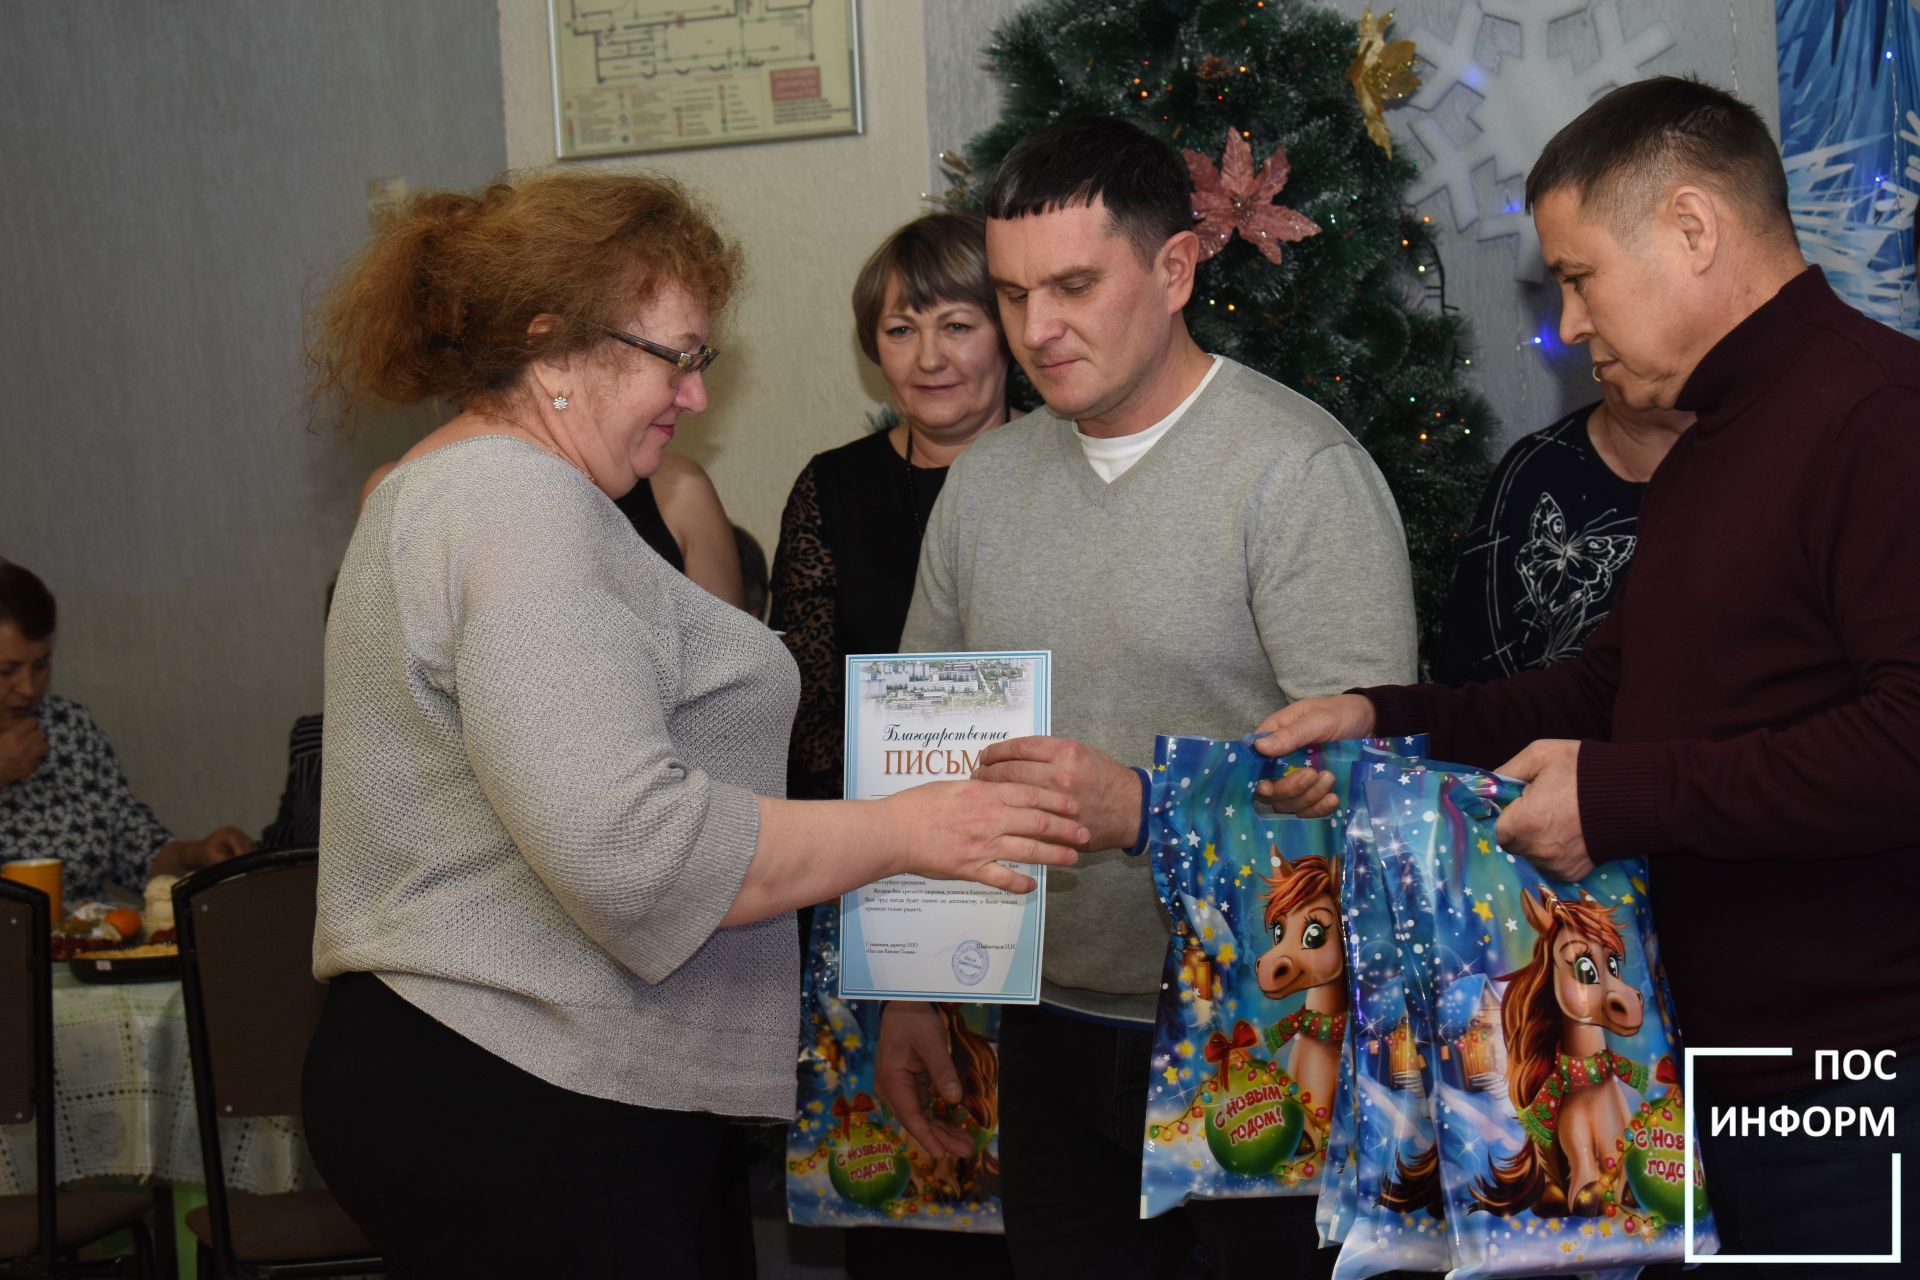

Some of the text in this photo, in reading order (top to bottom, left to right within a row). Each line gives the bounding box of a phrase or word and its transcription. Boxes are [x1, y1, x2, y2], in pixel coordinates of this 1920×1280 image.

[883, 723, 1009, 748] Благодарственное
[884, 749, 983, 775] ПИСЬМ
[1215, 1085, 1283, 1129] С НОВЫМ
[1229, 1106, 1283, 1145] ГОДОМ!
[1635, 1129, 1648, 1148] С
[836, 1143, 894, 1167] С НОВЫМ
[850, 1158, 893, 1181] ГОДОМ!
